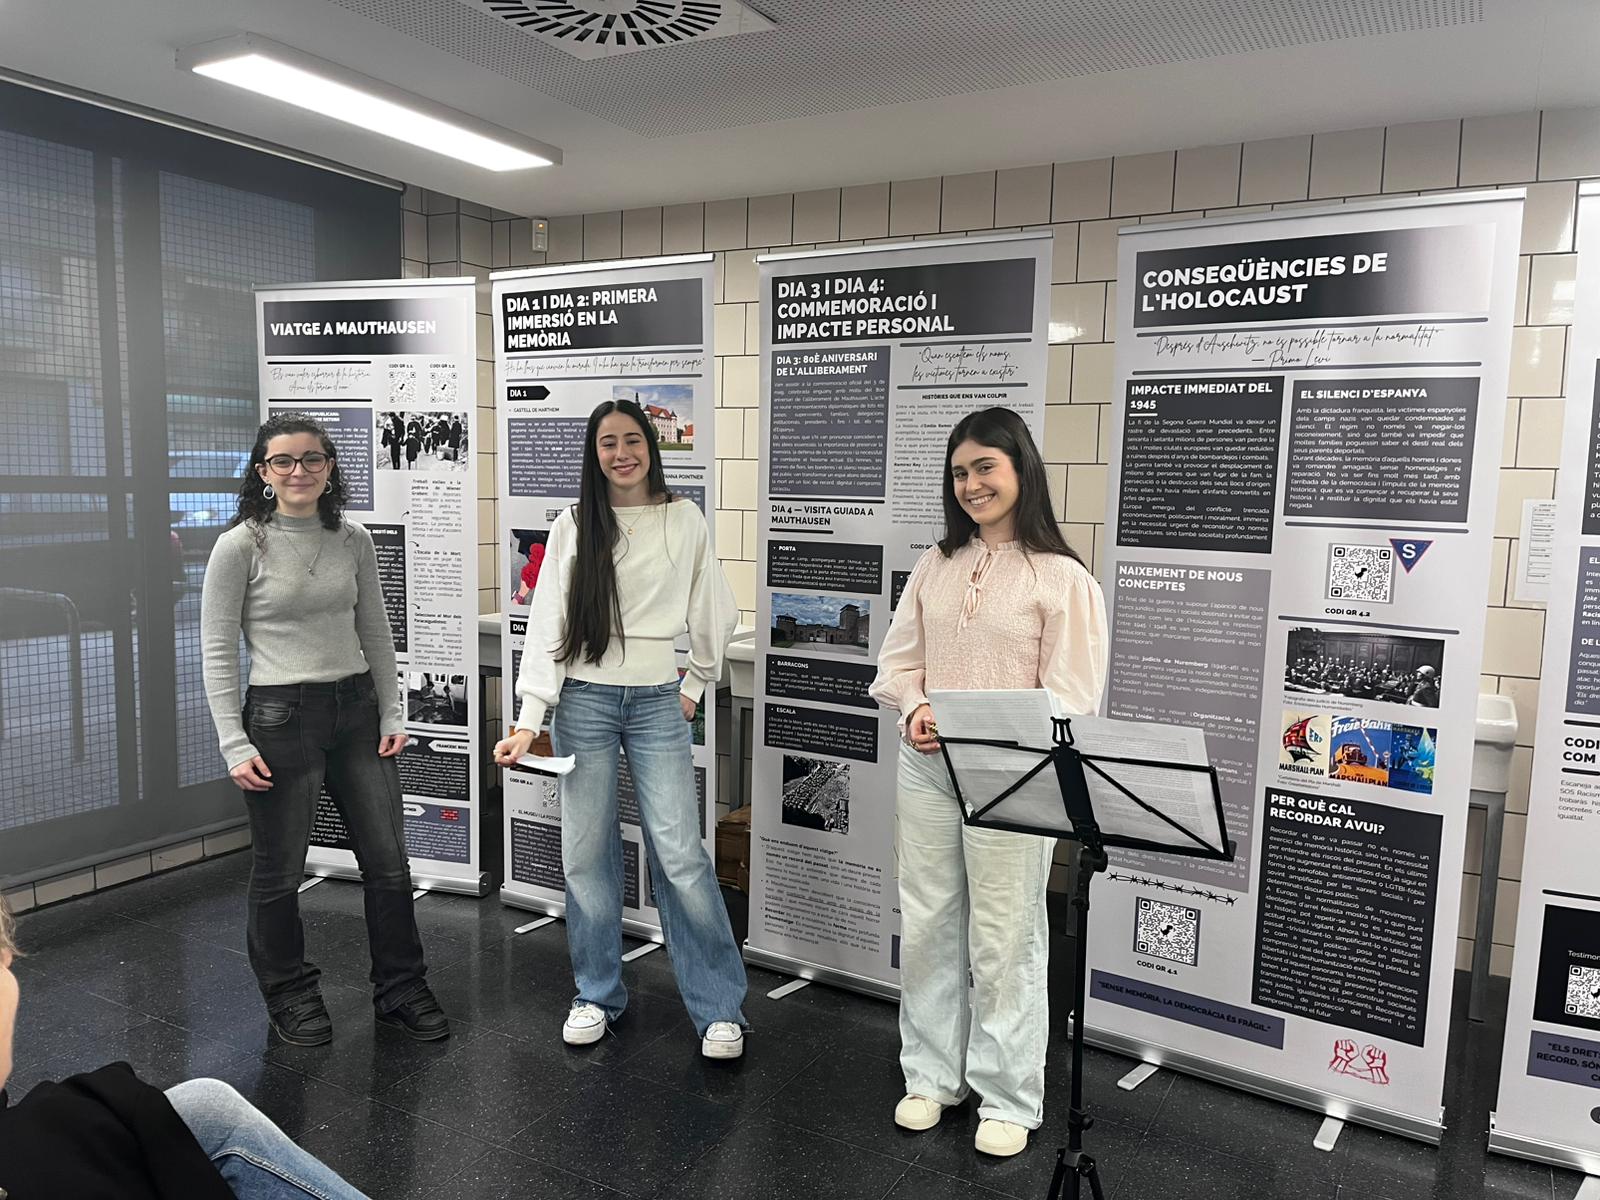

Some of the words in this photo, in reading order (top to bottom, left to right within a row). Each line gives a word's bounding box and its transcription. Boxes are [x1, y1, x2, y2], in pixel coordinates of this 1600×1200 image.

[1143, 255, 1346, 287] CONSEQÜÈNCIES
[1352, 252, 1387, 273] DE
[778, 281, 806, 298] DIA
[810, 283, 820, 298] 3
[825, 279, 830, 295] I
[834, 277, 864, 294] DIA
[868, 278, 884, 294] 4:
[506, 297, 530, 312] DIA
[531, 298, 541, 310] 1
[543, 296, 548, 309] I
[549, 293, 574, 308] DIA
[576, 294, 590, 306] 2:
[592, 287, 657, 305] PRIMERA
[1142, 283, 1308, 311] L'HOLOCAUST
[777, 290, 927, 318] COMMEMORACIÓ
[931, 293, 937, 309] I
[507, 309, 573, 330] IMMERSIÓ
[577, 311, 596, 326] EN
[599, 309, 618, 324] LA
[270, 322, 320, 335] VIATGE
[323, 322, 333, 334] A
[336, 320, 436, 334] MAUTHAUSEN
[777, 320, 852, 339] IMPACTE
[856, 314, 954, 335] PERSONAL
[507, 330, 572, 348] MEMÒRIA
[1328, 331, 1360, 349] tornar
[1371, 327, 1382, 346] la
[776, 356, 791, 364] DIA
[793, 356, 801, 365] 3:
[803, 352, 819, 363] 80È
[821, 351, 877, 363] ANIVERSARI
[976, 345, 987, 361] els
[1269, 350, 1301, 370] Primo
[1305, 348, 1330, 368] Levi
[776, 367, 787, 376] DE
[789, 364, 867, 376] L'ALLIBERAMENT
[509, 389, 521, 397] DIA
[1131, 384, 1181, 395] IMPACTE
[1184, 382, 1245, 394] IMMEDIAT
[1247, 382, 1272, 393] DEL
[1300, 390, 1314, 398] EL
[1316, 389, 1360, 398] SILENCI
[1362, 388, 1427, 398] D'ESPANYA
[1129, 400, 1156, 409] 1945
[771, 504, 785, 512] DIA
[804, 505, 831, 514] VISITA
[833, 506, 866, 516] GUIADA
[867, 508, 874, 516] A
[771, 515, 830, 525] MAUTHAUSEN
[1402, 543, 1416, 558] S
[1119, 565, 1186, 578] NAIXEMENT
[1188, 569, 1205, 580] DE
[1207, 571, 1243, 582] NOUS
[1118, 578, 1186, 591] CONCEPTES
[1583, 594, 1597, 602] fake
[1325, 607, 1344, 615] CODI
[1345, 608, 1357, 616] QR
[513, 623, 525, 631] DIA
[1581, 637, 1594, 645] DE
[777, 660, 808, 668] BARRACONS
[1174, 658, 1207, 668] Nuremberg
[1563, 751, 1596, 763] COM
[1560, 780, 1591, 789] Escaneja
[1270, 793, 1295, 807] PER
[1297, 798, 1326, 812] QUÈ
[1328, 803, 1355, 816] CAL
[1558, 805, 1592, 813] concretes
[1269, 807, 1342, 828] RECORDAR
[1343, 819, 1384, 835] AVUI?
[1269, 826, 1297, 837] Recordar
[1312, 834, 1324, 842] que
[1341, 838, 1363, 847] passar
[1136, 959, 1154, 969] CODI
[1155, 964, 1166, 972] QR
[1098, 980, 1124, 994] "SENSE
[1163, 997, 1173, 1006] LA
[1174, 1000, 1225, 1019] DEMOCRÀCIA
[1227, 1012, 1236, 1023] ÉS
[1548, 1042, 1570, 1053] "ELS
